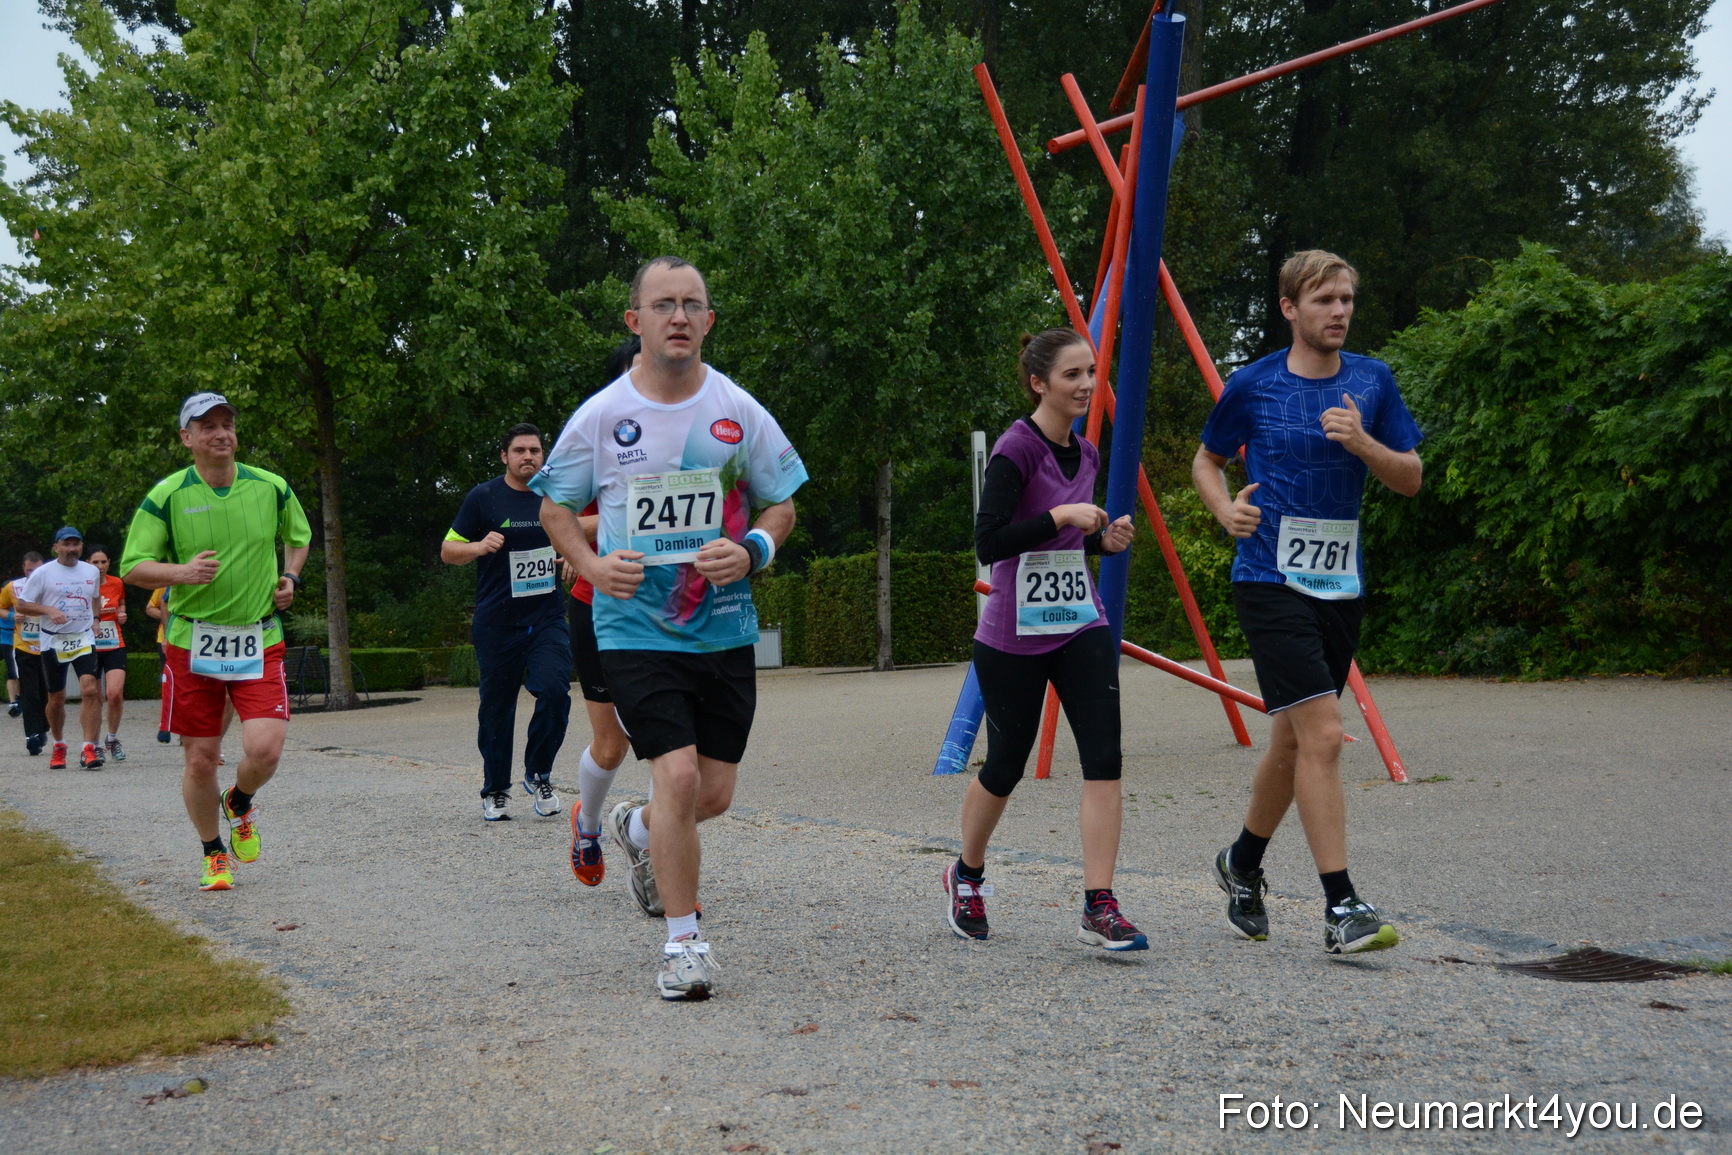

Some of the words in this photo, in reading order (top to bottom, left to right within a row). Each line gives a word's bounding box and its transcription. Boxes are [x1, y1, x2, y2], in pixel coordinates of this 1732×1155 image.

[617, 448, 647, 461] PARTL
[618, 456, 648, 466] Neumarkt
[668, 472, 713, 486] BOCK
[636, 491, 716, 531] 2477
[1322, 522, 1354, 533] BOCK
[655, 536, 704, 552] Damian
[1286, 537, 1350, 571] 2761
[516, 557, 555, 580] 2294
[526, 580, 549, 590] Roman
[1026, 570, 1087, 603] 2335
[1297, 576, 1342, 591] Matthias
[1042, 610, 1078, 623] Louisa
[23, 622, 40, 632] 271
[199, 633, 258, 658] 2418
[220, 663, 235, 672] Ivo
